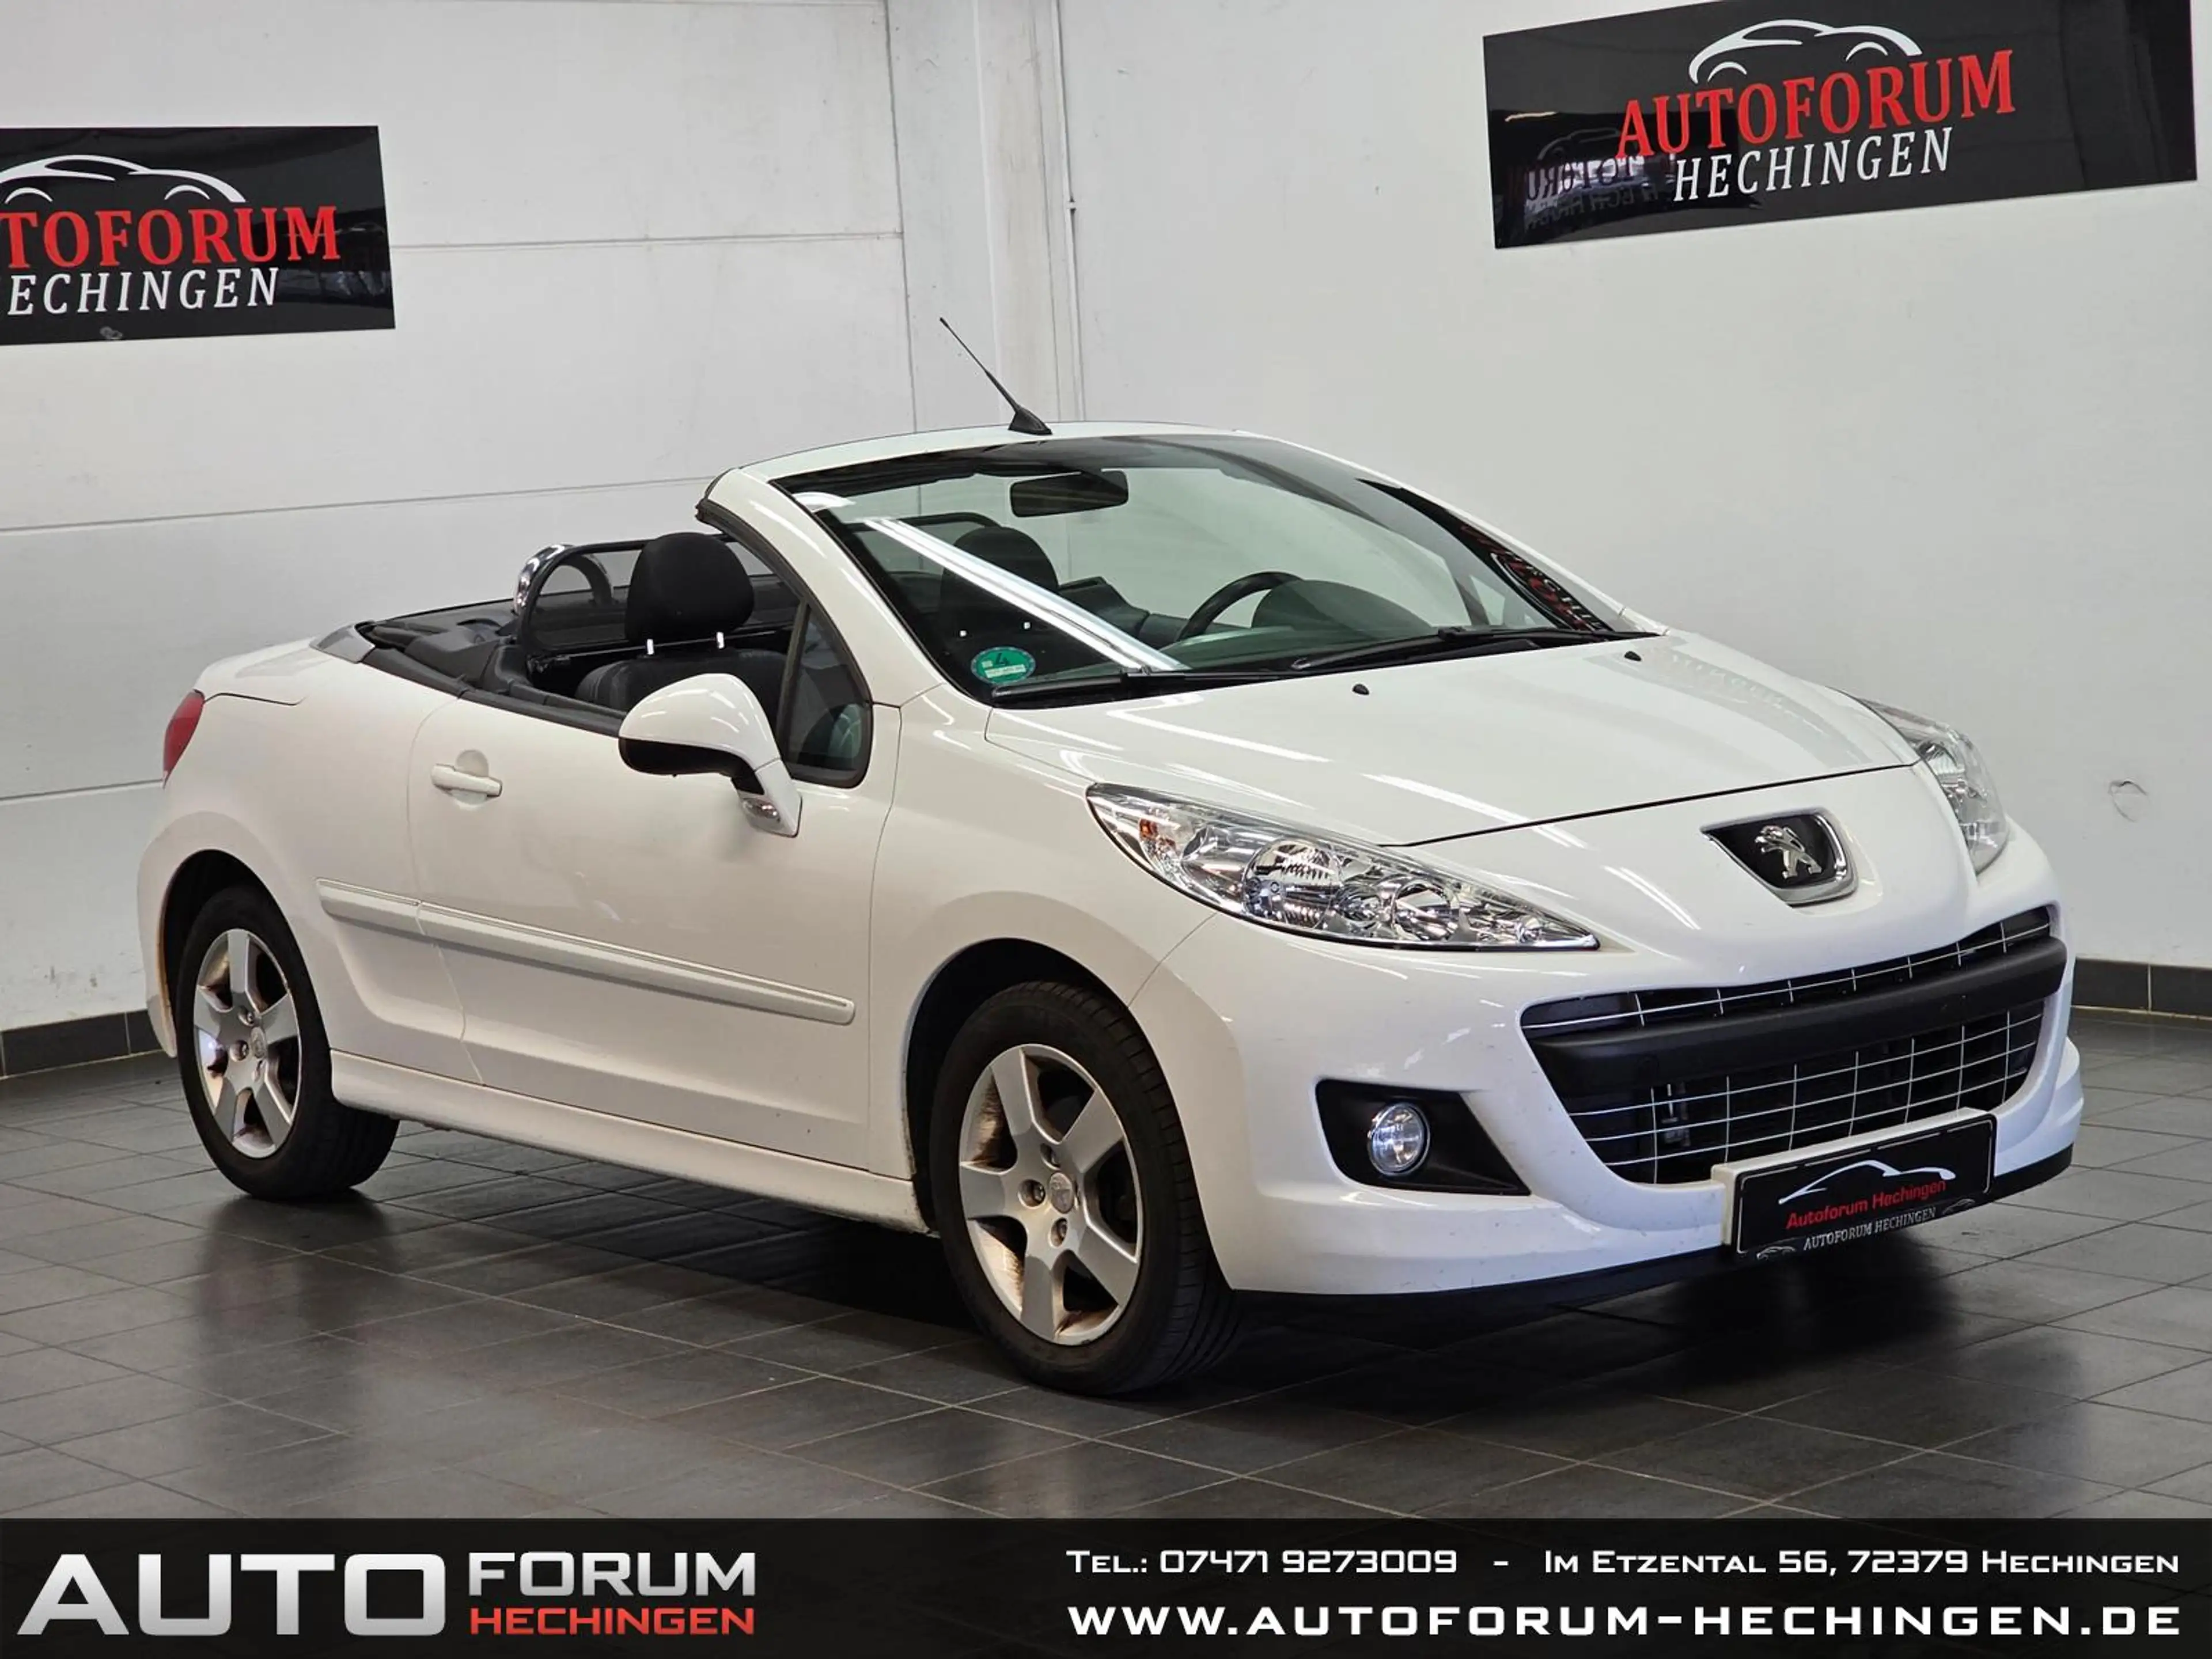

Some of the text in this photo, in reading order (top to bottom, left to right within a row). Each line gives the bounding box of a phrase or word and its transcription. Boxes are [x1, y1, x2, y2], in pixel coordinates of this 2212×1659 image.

[1615, 50, 2014, 160] AUTOFORUM
[1673, 127, 1952, 202] HECHINGEN
[0, 205, 340, 268] TOFORUM
[7, 267, 279, 316] ECHINGEN
[1786, 1180, 1946, 1229] Autoforum Hechingen
[1804, 1207, 1937, 1251] AUTOFORUM HECHINGEN
